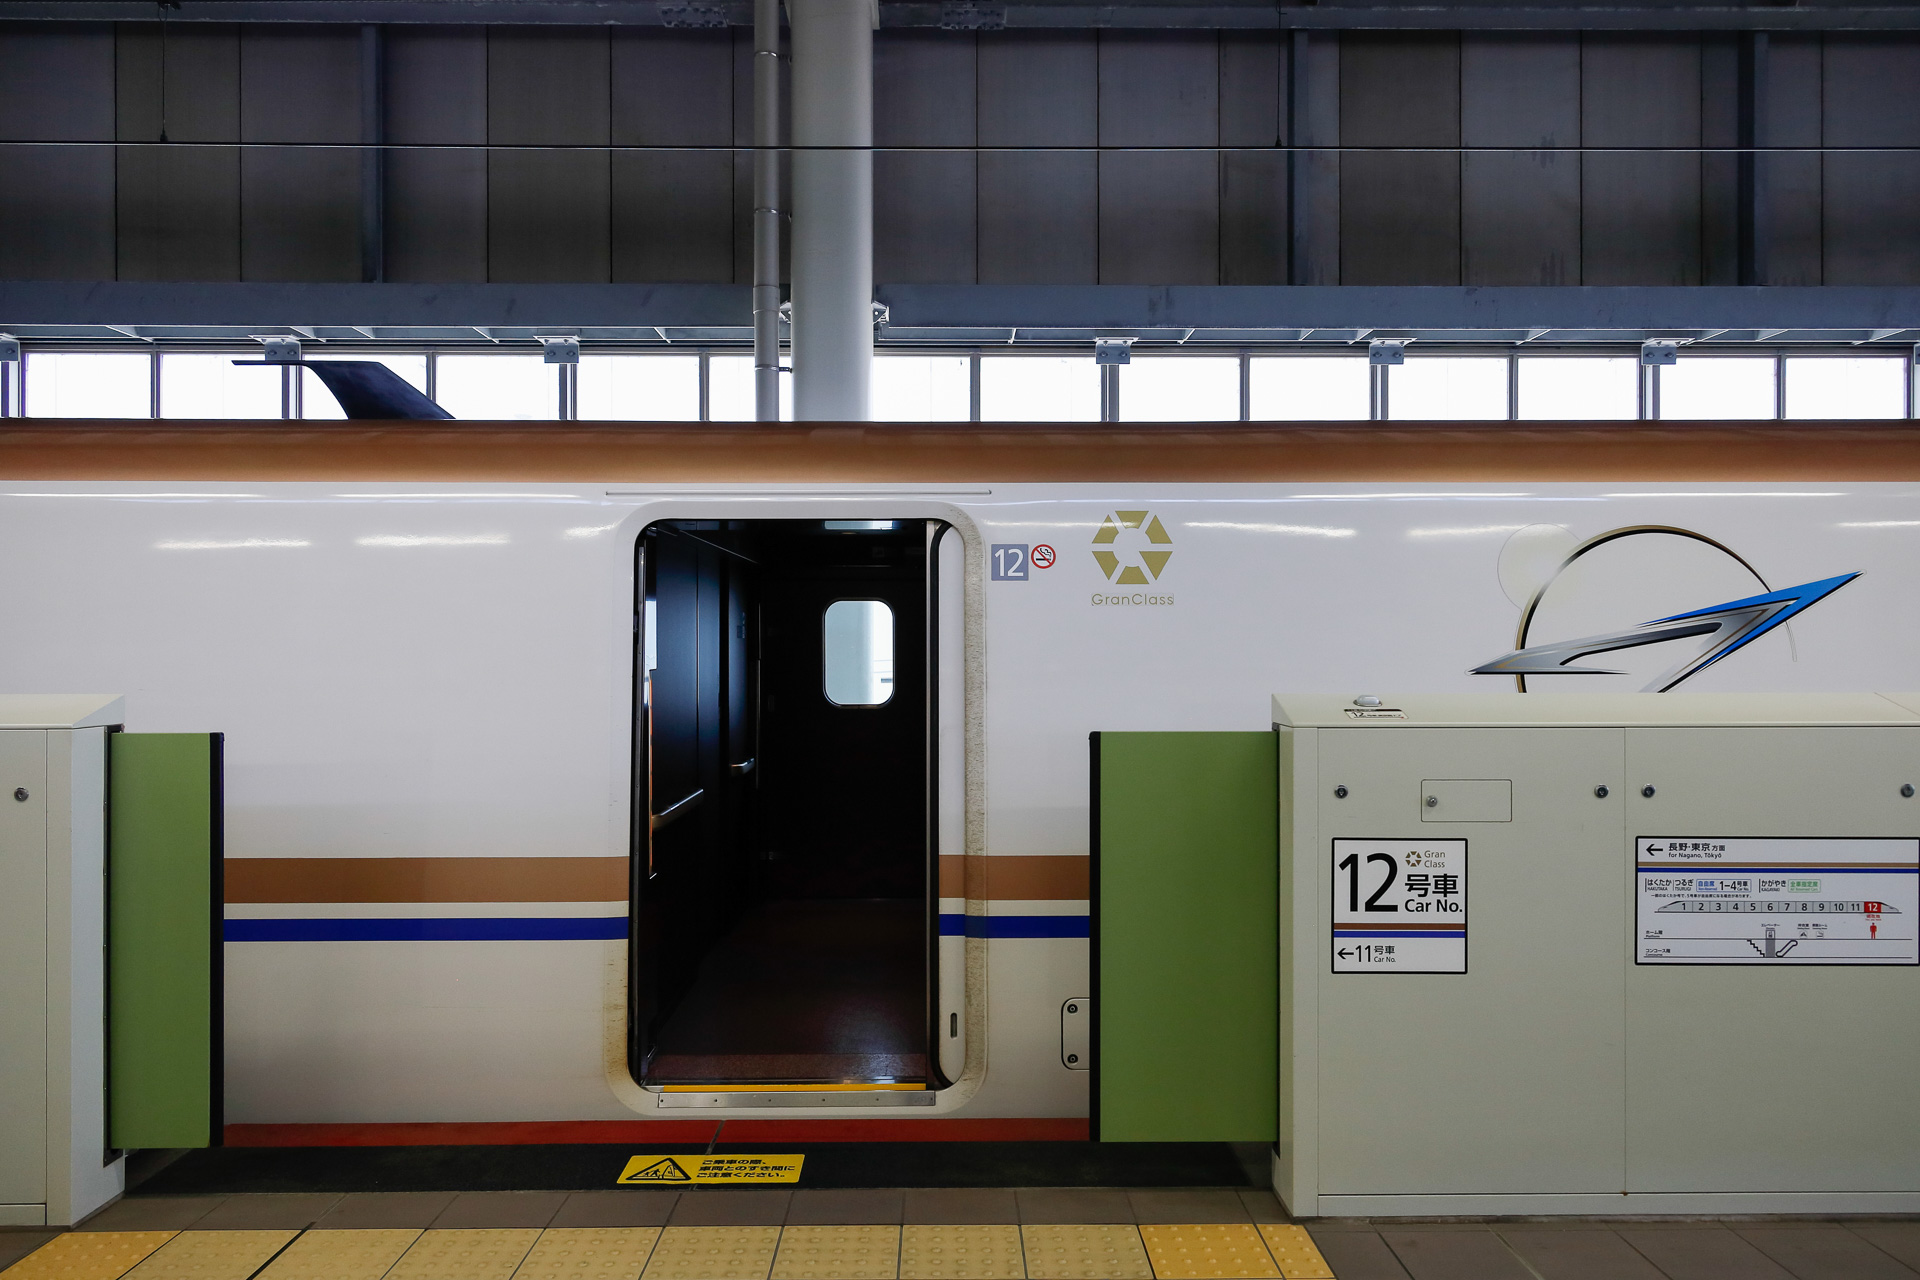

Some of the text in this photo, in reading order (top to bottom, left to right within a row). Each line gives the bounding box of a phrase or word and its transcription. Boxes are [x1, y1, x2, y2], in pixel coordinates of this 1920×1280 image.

[994, 548, 1024, 577] 12
[1091, 593, 1174, 606] GranClass
[1424, 850, 1446, 858] Gran
[1678, 852, 1703, 860] Nagano,
[1424, 860, 1446, 868] Class
[1338, 852, 1459, 912] 12 号車
[1647, 879, 1673, 887] はくたか
[1674, 879, 1694, 887] つるぎ
[1404, 899, 1463, 912] Car No.
[1698, 903, 1704, 911] 2
[1715, 903, 1721, 911] 3
[1733, 903, 1739, 911] 4
[1750, 903, 1756, 911] 5
[1767, 903, 1773, 911] 6
[1784, 903, 1790, 911] 7
[1801, 903, 1807, 911] 8
[1818, 903, 1825, 911] 9
[1834, 903, 1844, 911] 10
[1851, 903, 1860, 911] 11
[1867, 903, 1878, 911] 12
[1355, 945, 1396, 962] 11 号車
